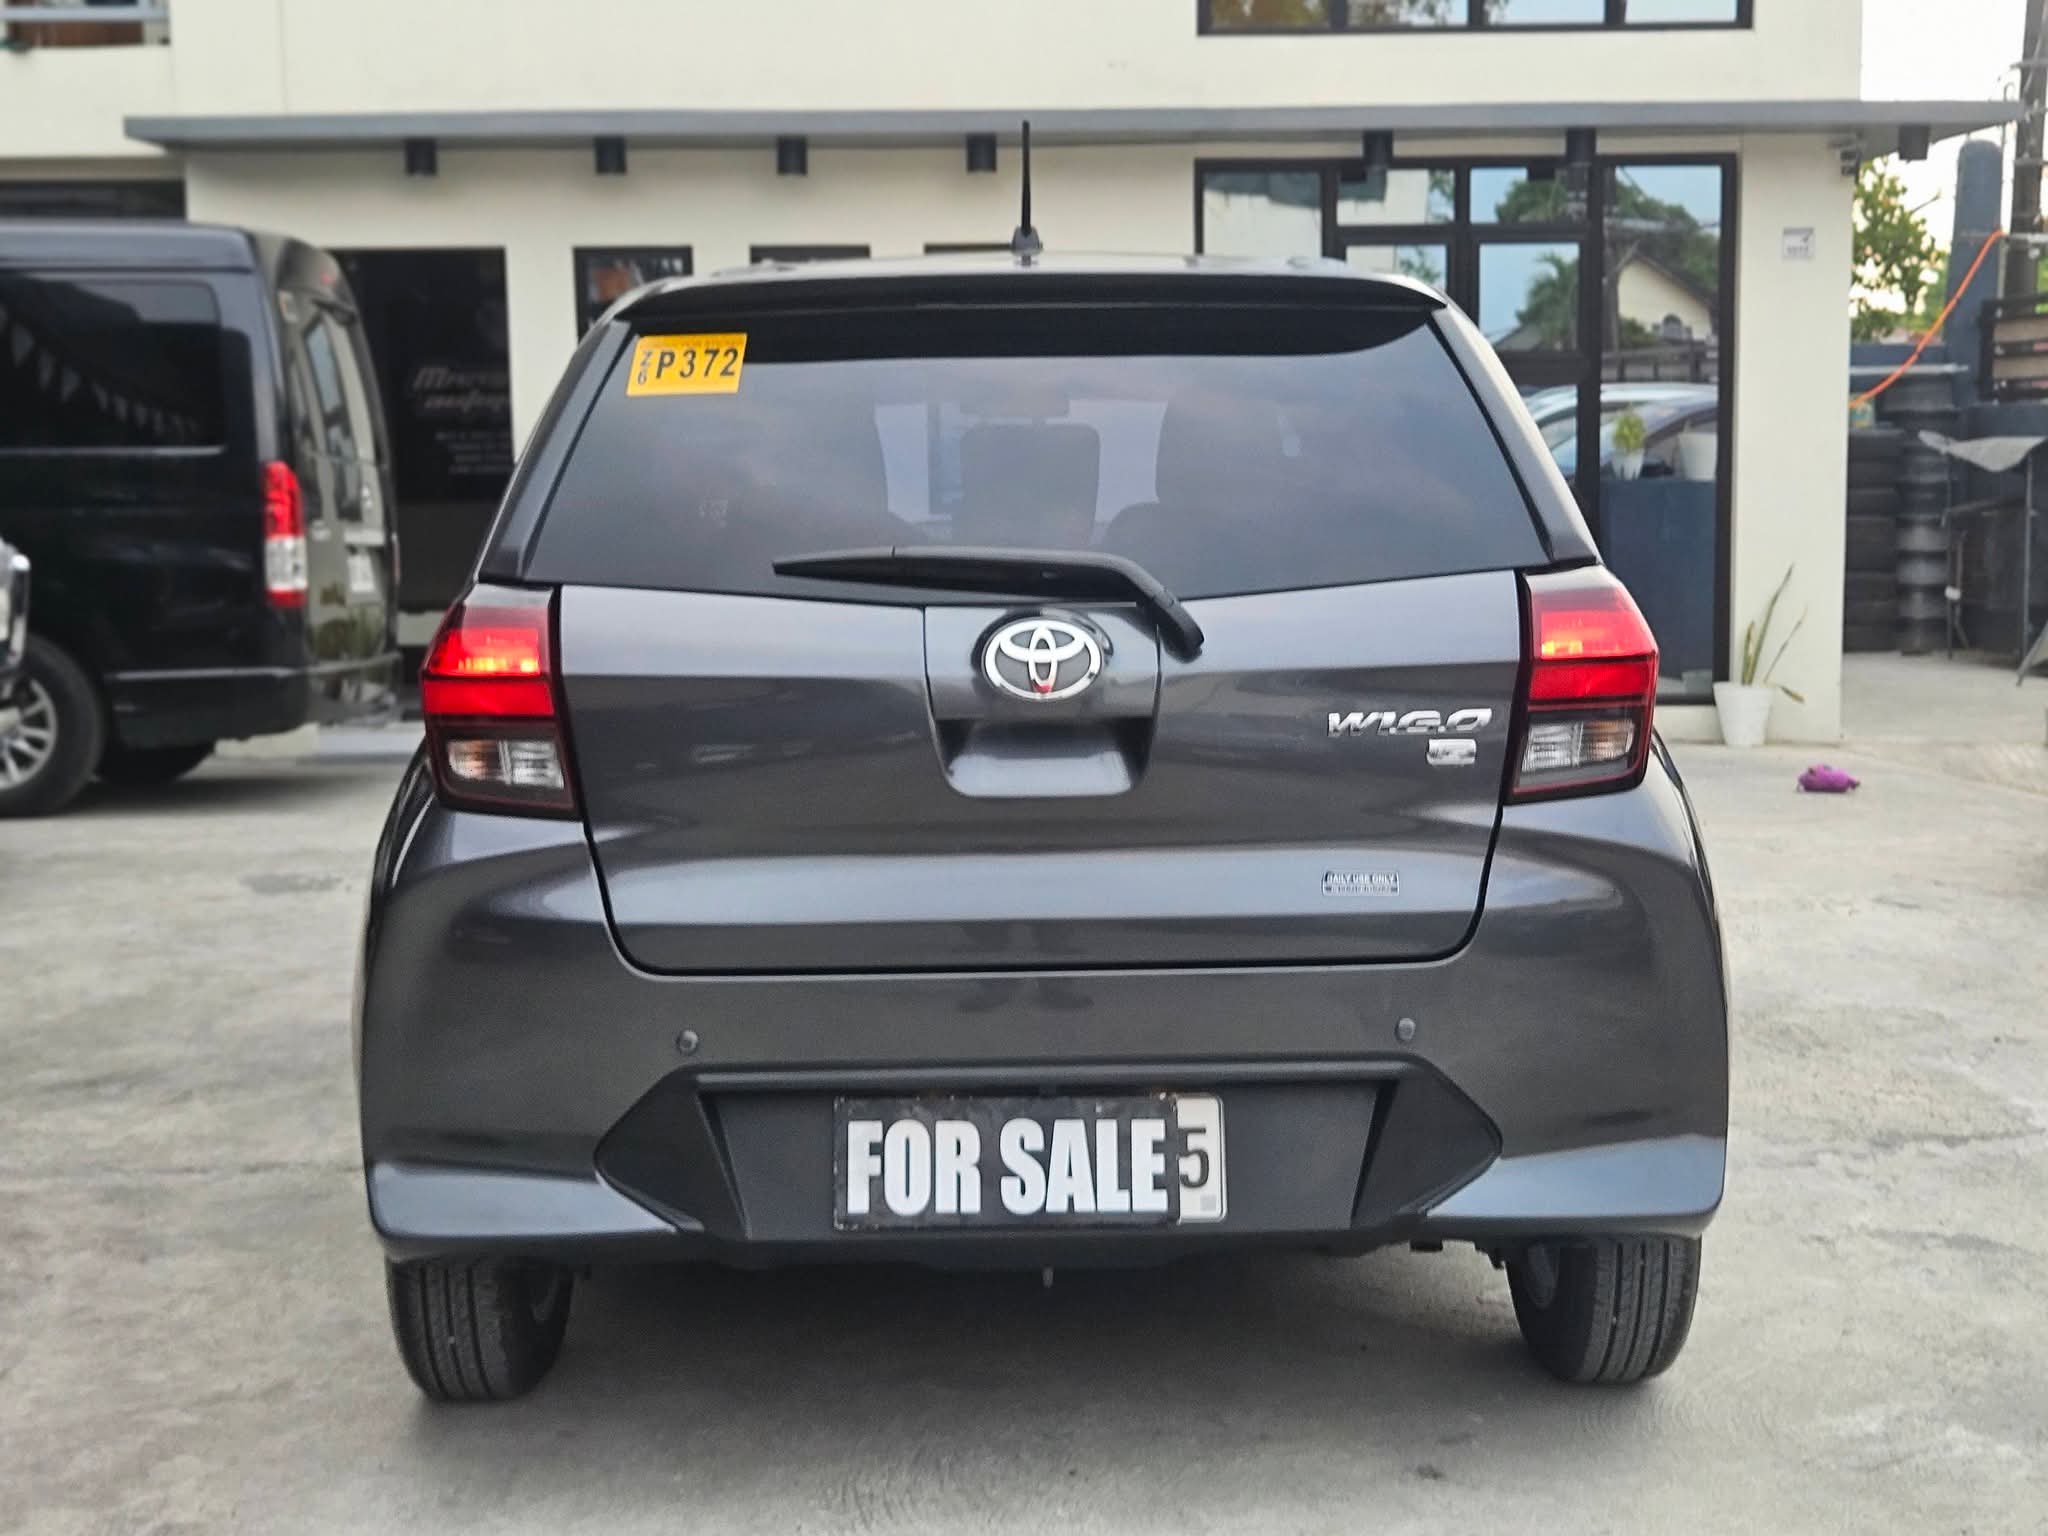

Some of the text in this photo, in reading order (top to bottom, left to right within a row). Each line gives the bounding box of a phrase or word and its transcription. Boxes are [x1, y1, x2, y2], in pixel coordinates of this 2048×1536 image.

[656, 348, 738, 379] P372
[847, 1117, 1168, 1216] FOR SALE
[1178, 1127, 1210, 1188] 5
